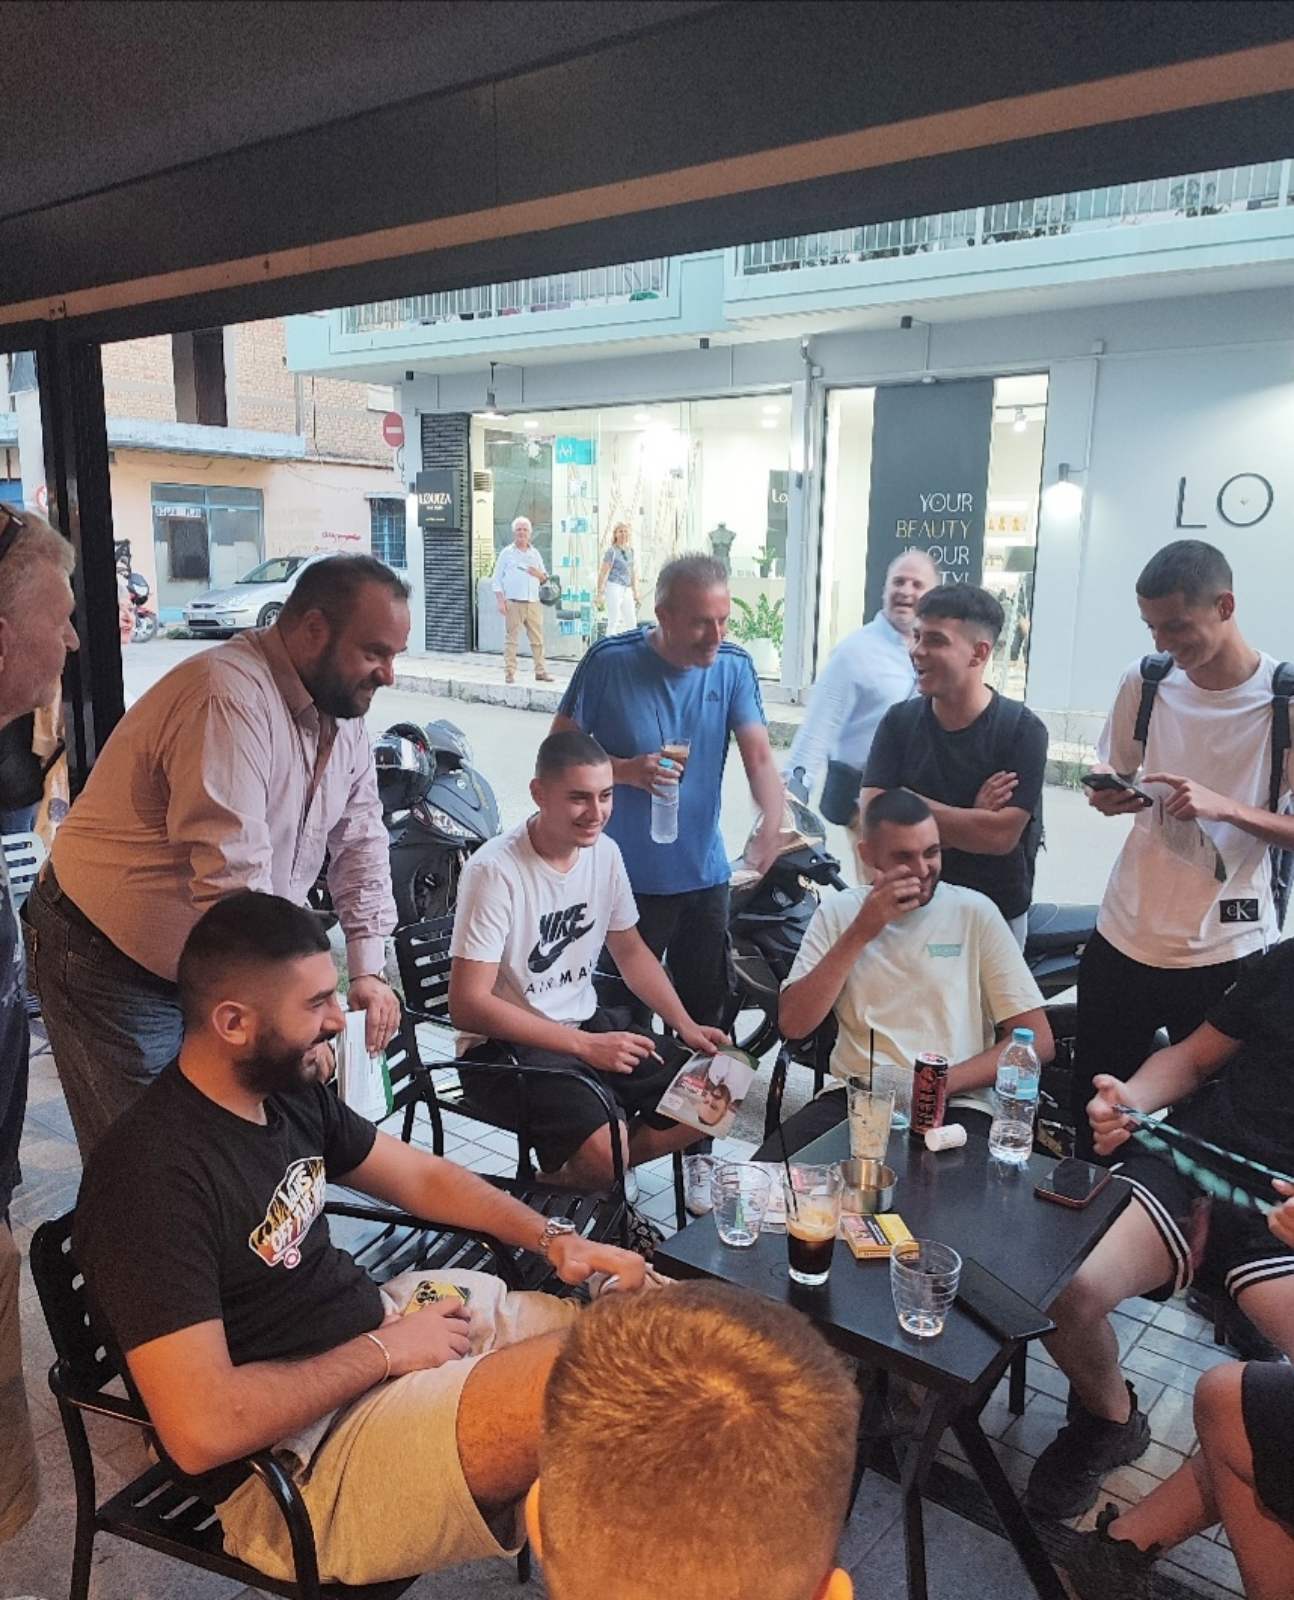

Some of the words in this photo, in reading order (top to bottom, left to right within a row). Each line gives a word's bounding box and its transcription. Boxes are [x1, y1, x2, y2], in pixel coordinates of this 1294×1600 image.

[920, 492, 973, 513] YOUR
[895, 519, 972, 539] BEAUTY
[927, 545, 969, 565] OUR
[539, 902, 588, 948] NIKE
[559, 958, 593, 985] MA
